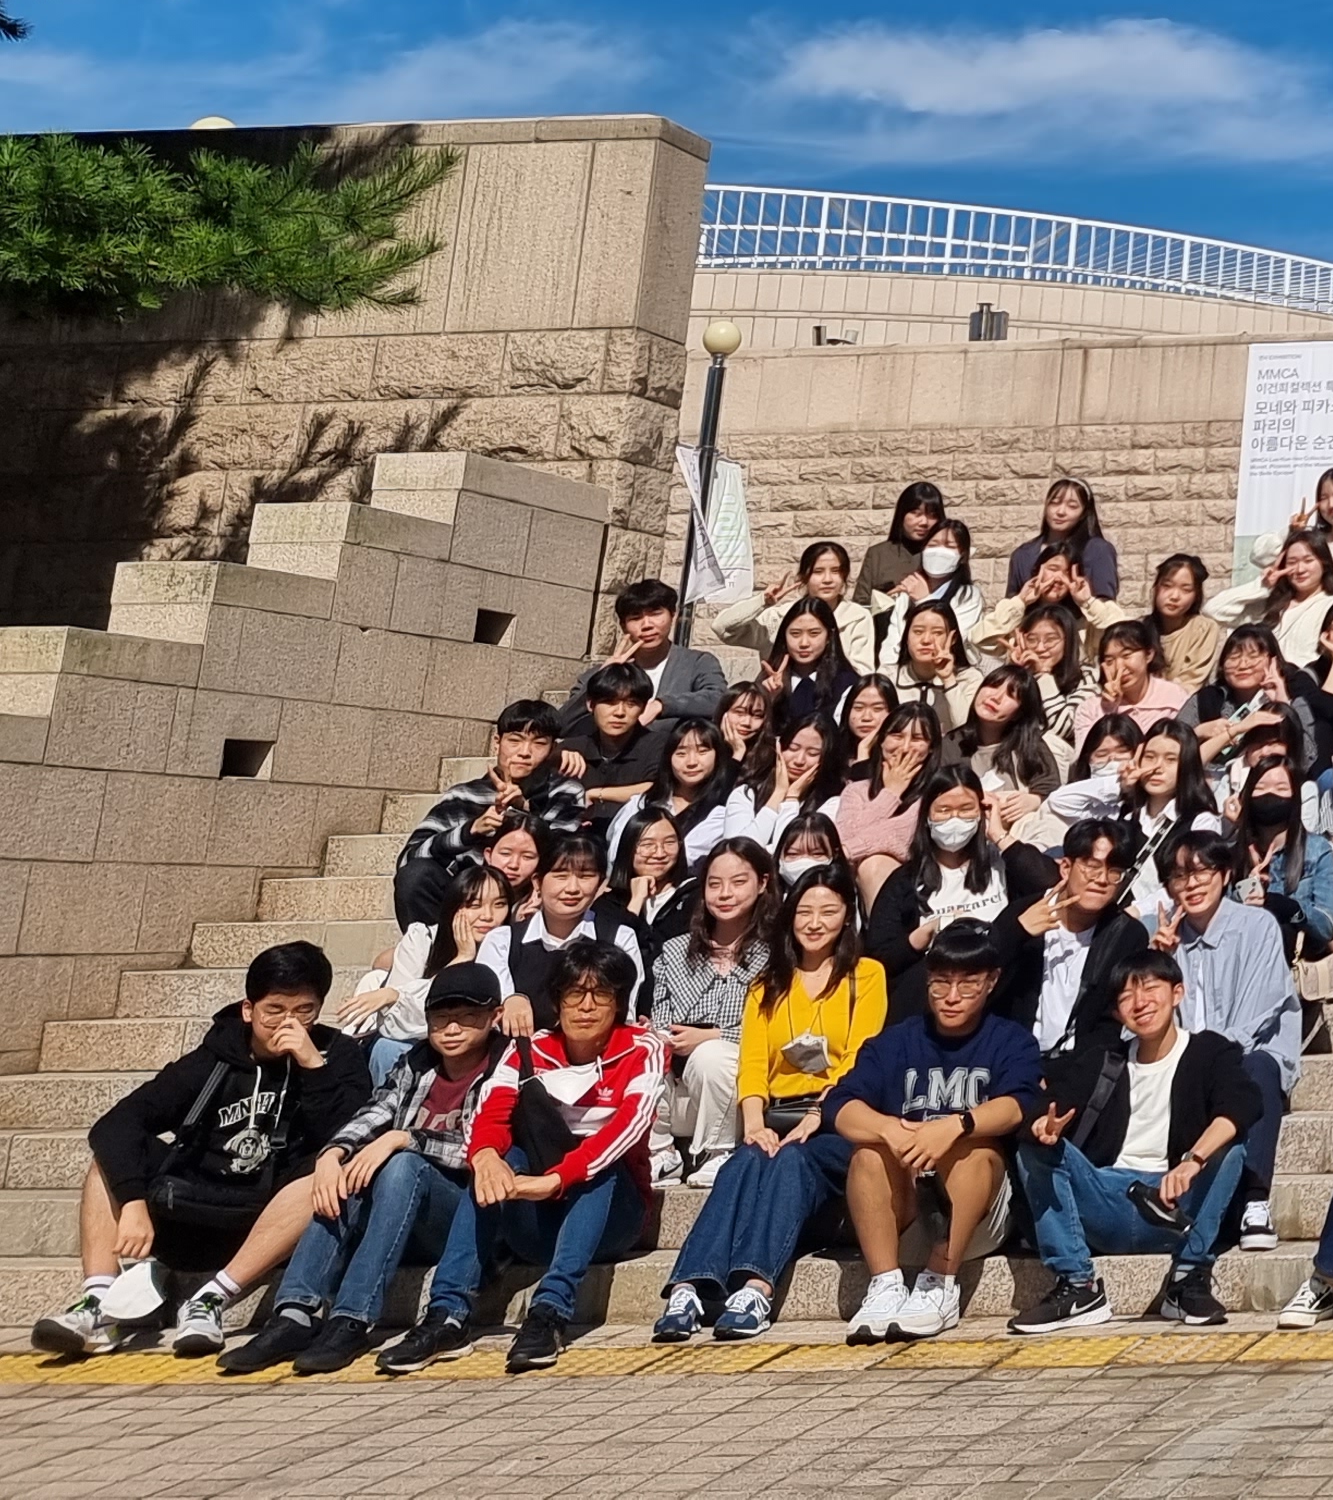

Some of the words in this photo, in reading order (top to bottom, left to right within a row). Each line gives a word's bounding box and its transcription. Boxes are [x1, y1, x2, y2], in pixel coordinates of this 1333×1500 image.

[1257, 368, 1299, 380] MMCA
[1254, 399, 1297, 415] 모네와
[1253, 417, 1296, 434] 파리의
[1251, 435, 1309, 452] 아름다운
[902, 1066, 990, 1115] LMC
